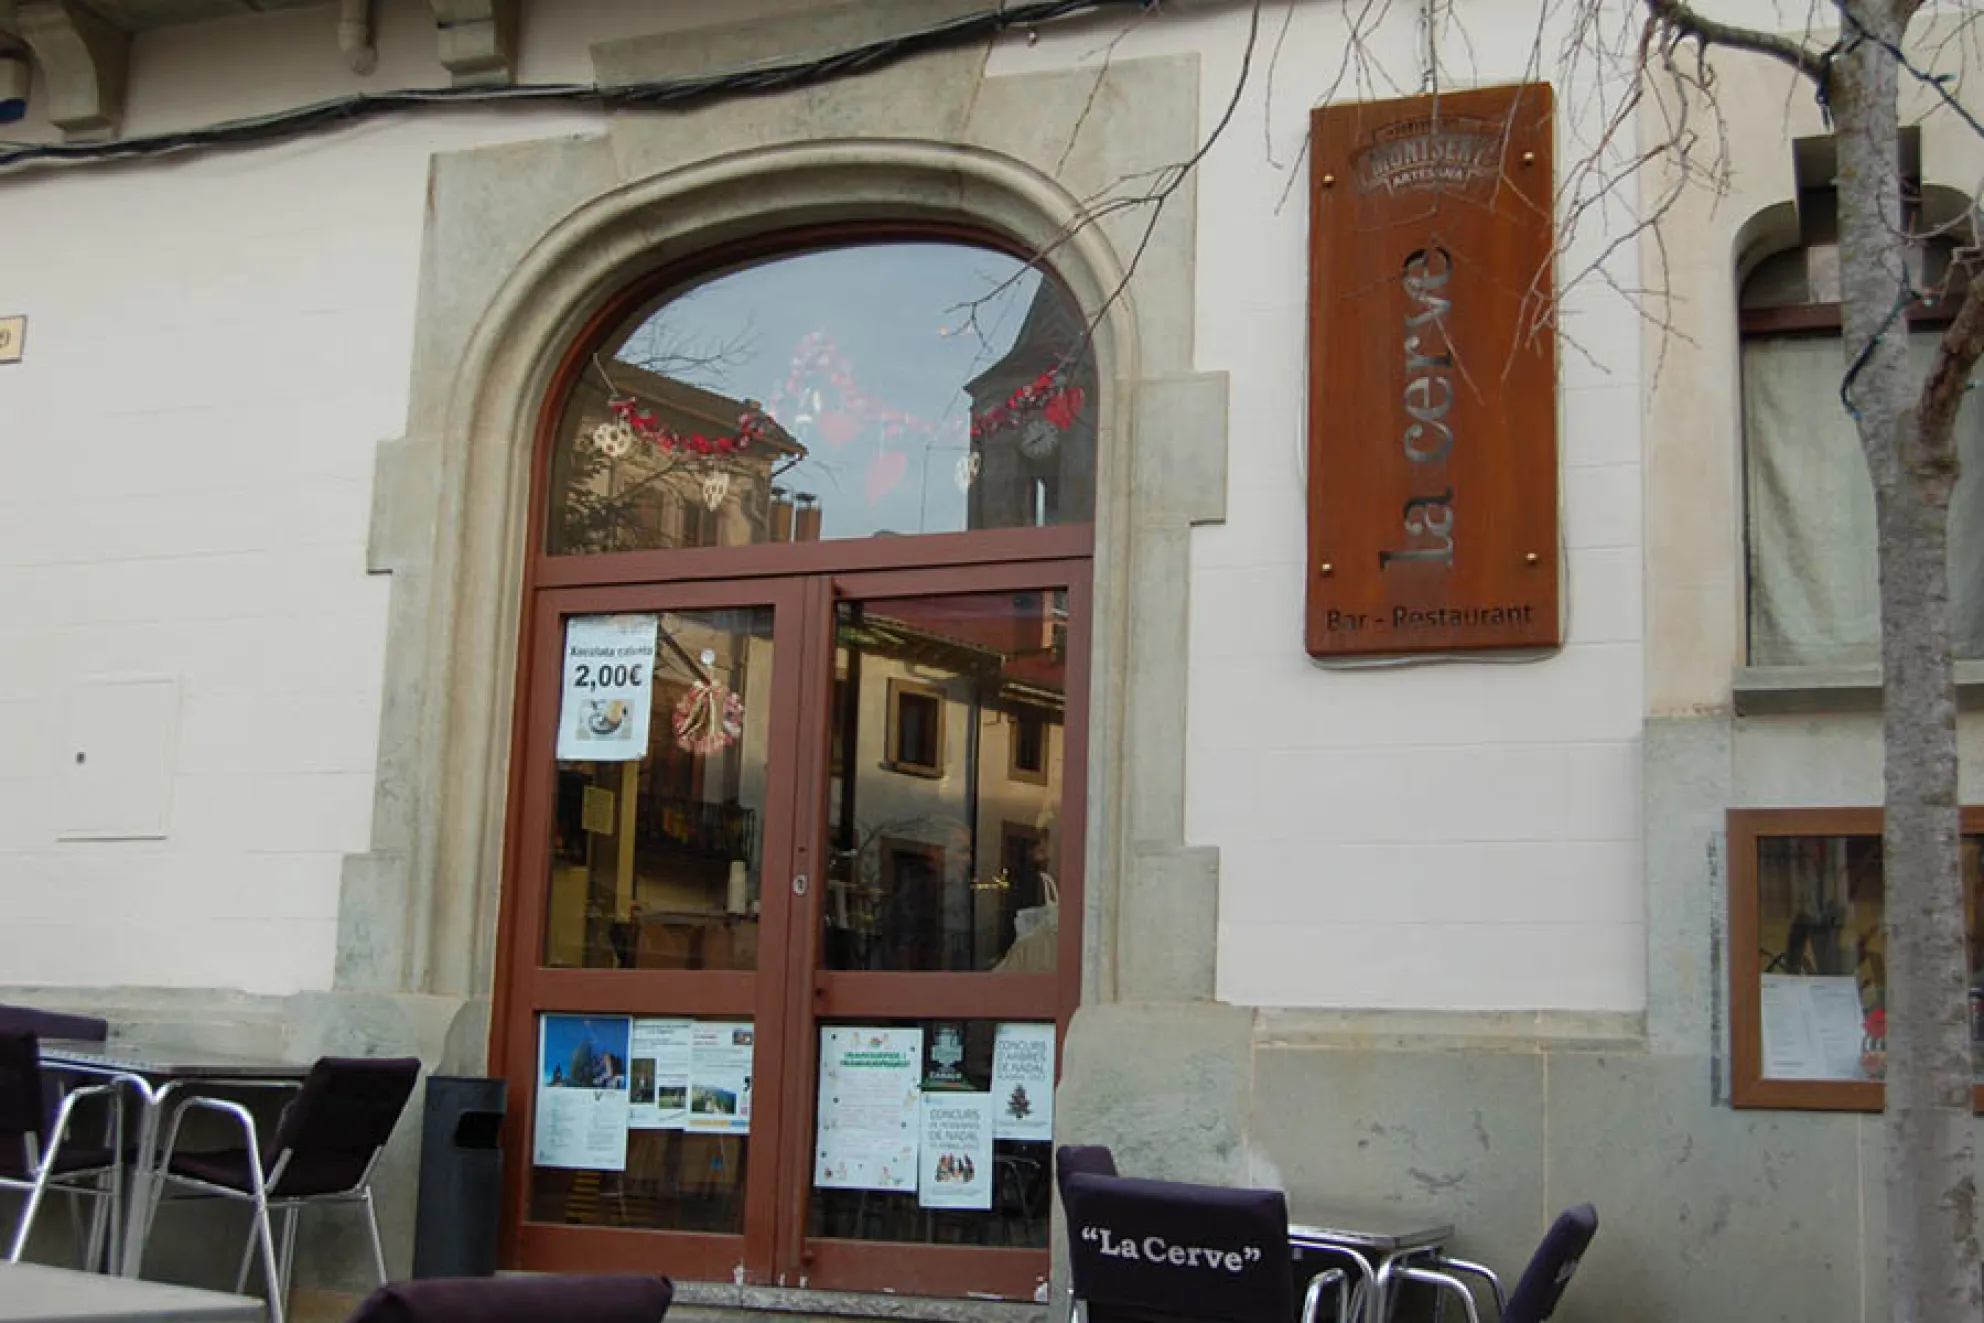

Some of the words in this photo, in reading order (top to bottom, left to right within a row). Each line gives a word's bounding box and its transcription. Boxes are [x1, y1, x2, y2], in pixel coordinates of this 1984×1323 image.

[1404, 246, 1453, 464] cerve
[1379, 487, 1453, 571] la
[1326, 608, 1368, 631] Bar
[1392, 603, 1536, 629] Restaurant
[574, 663, 644, 693] 2,00€
